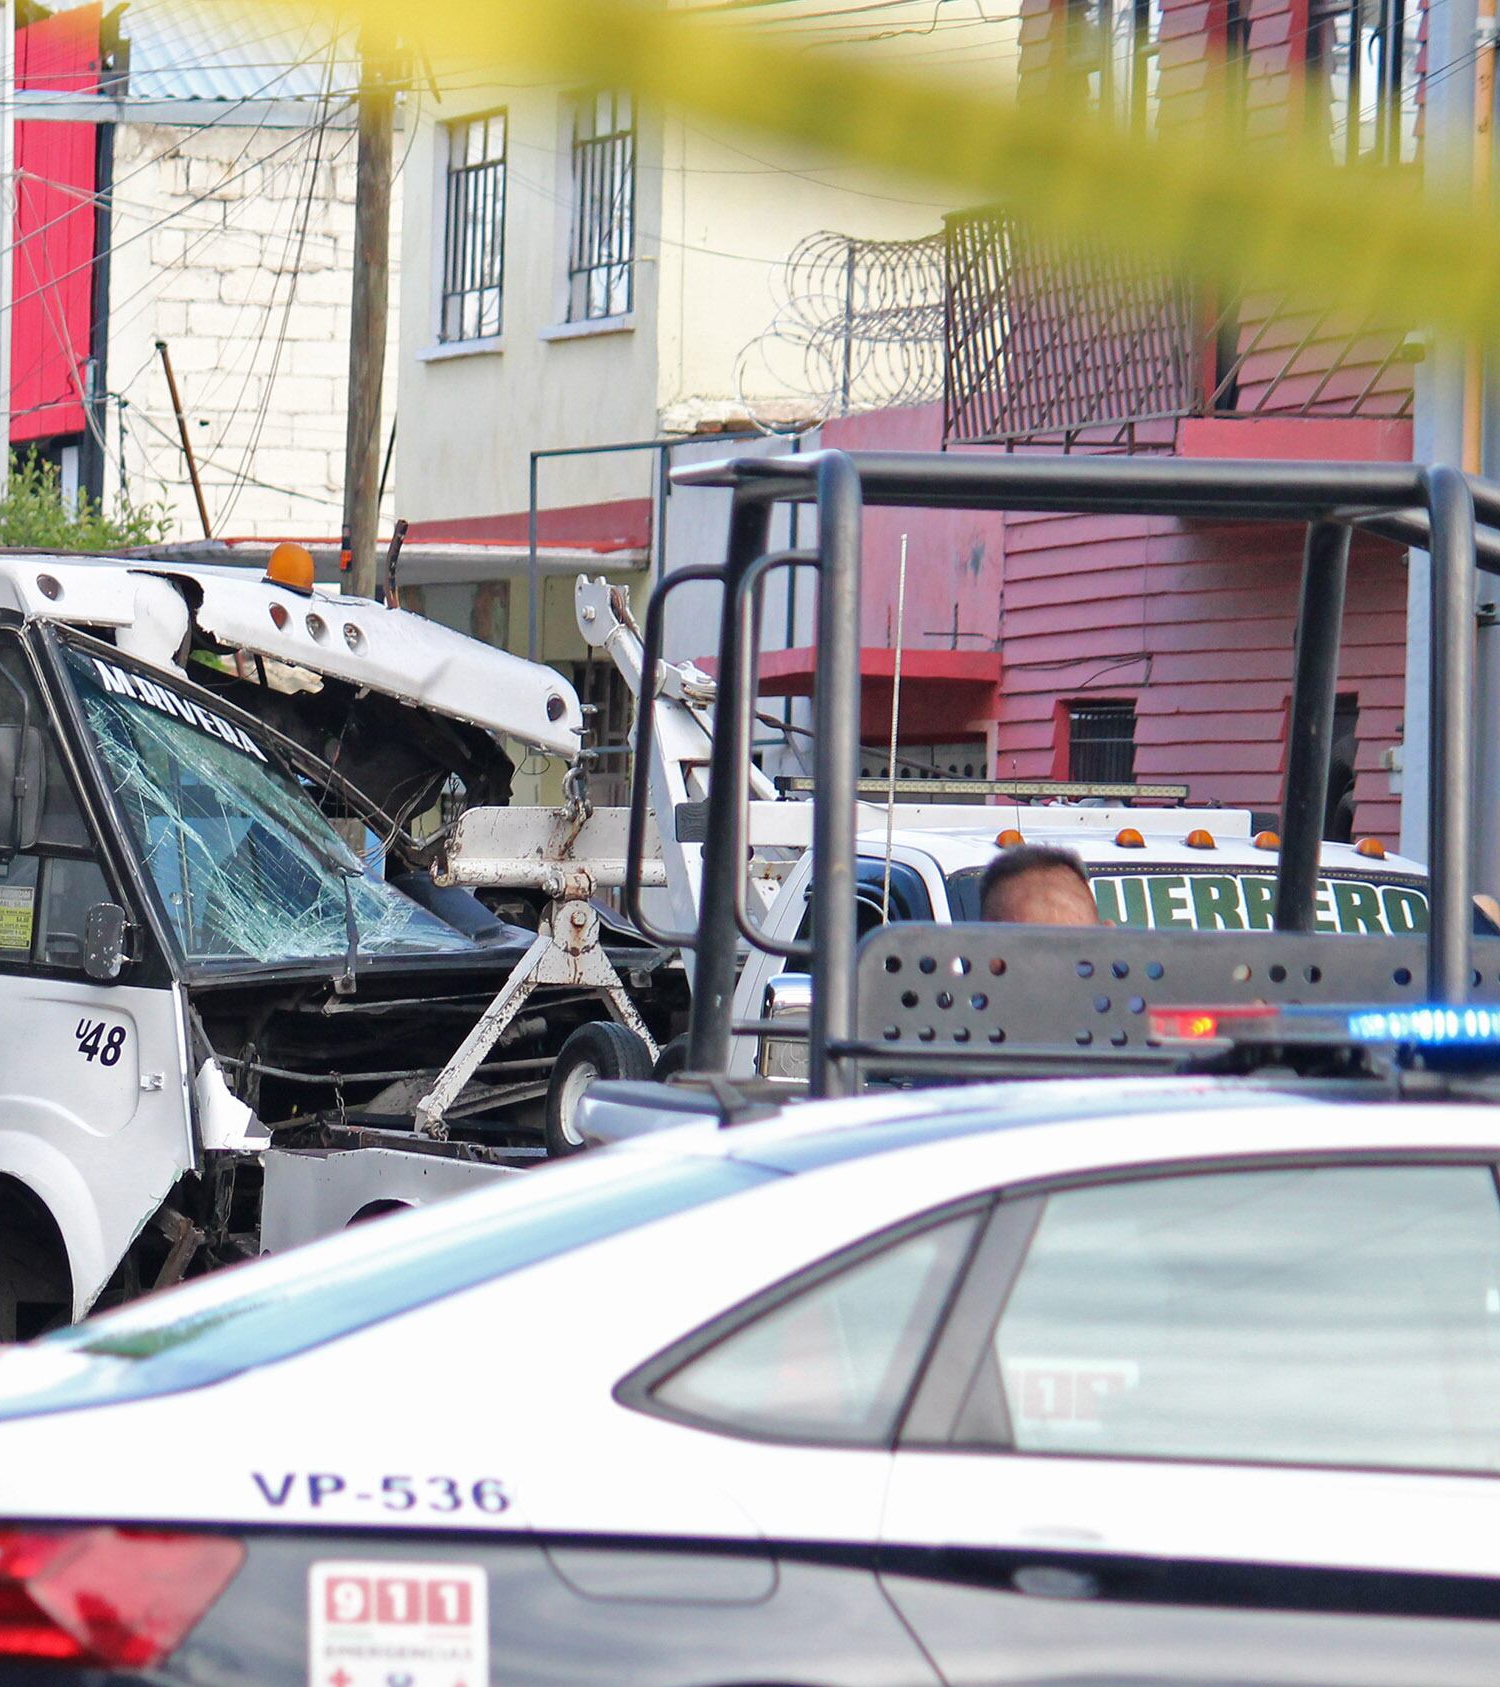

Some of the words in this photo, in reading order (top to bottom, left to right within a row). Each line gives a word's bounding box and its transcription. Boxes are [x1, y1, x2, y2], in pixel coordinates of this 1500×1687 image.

[1090, 874, 1429, 937] UERRERO
[251, 1472, 511, 1514] VP-536
[334, 1582, 459, 1622] 911
